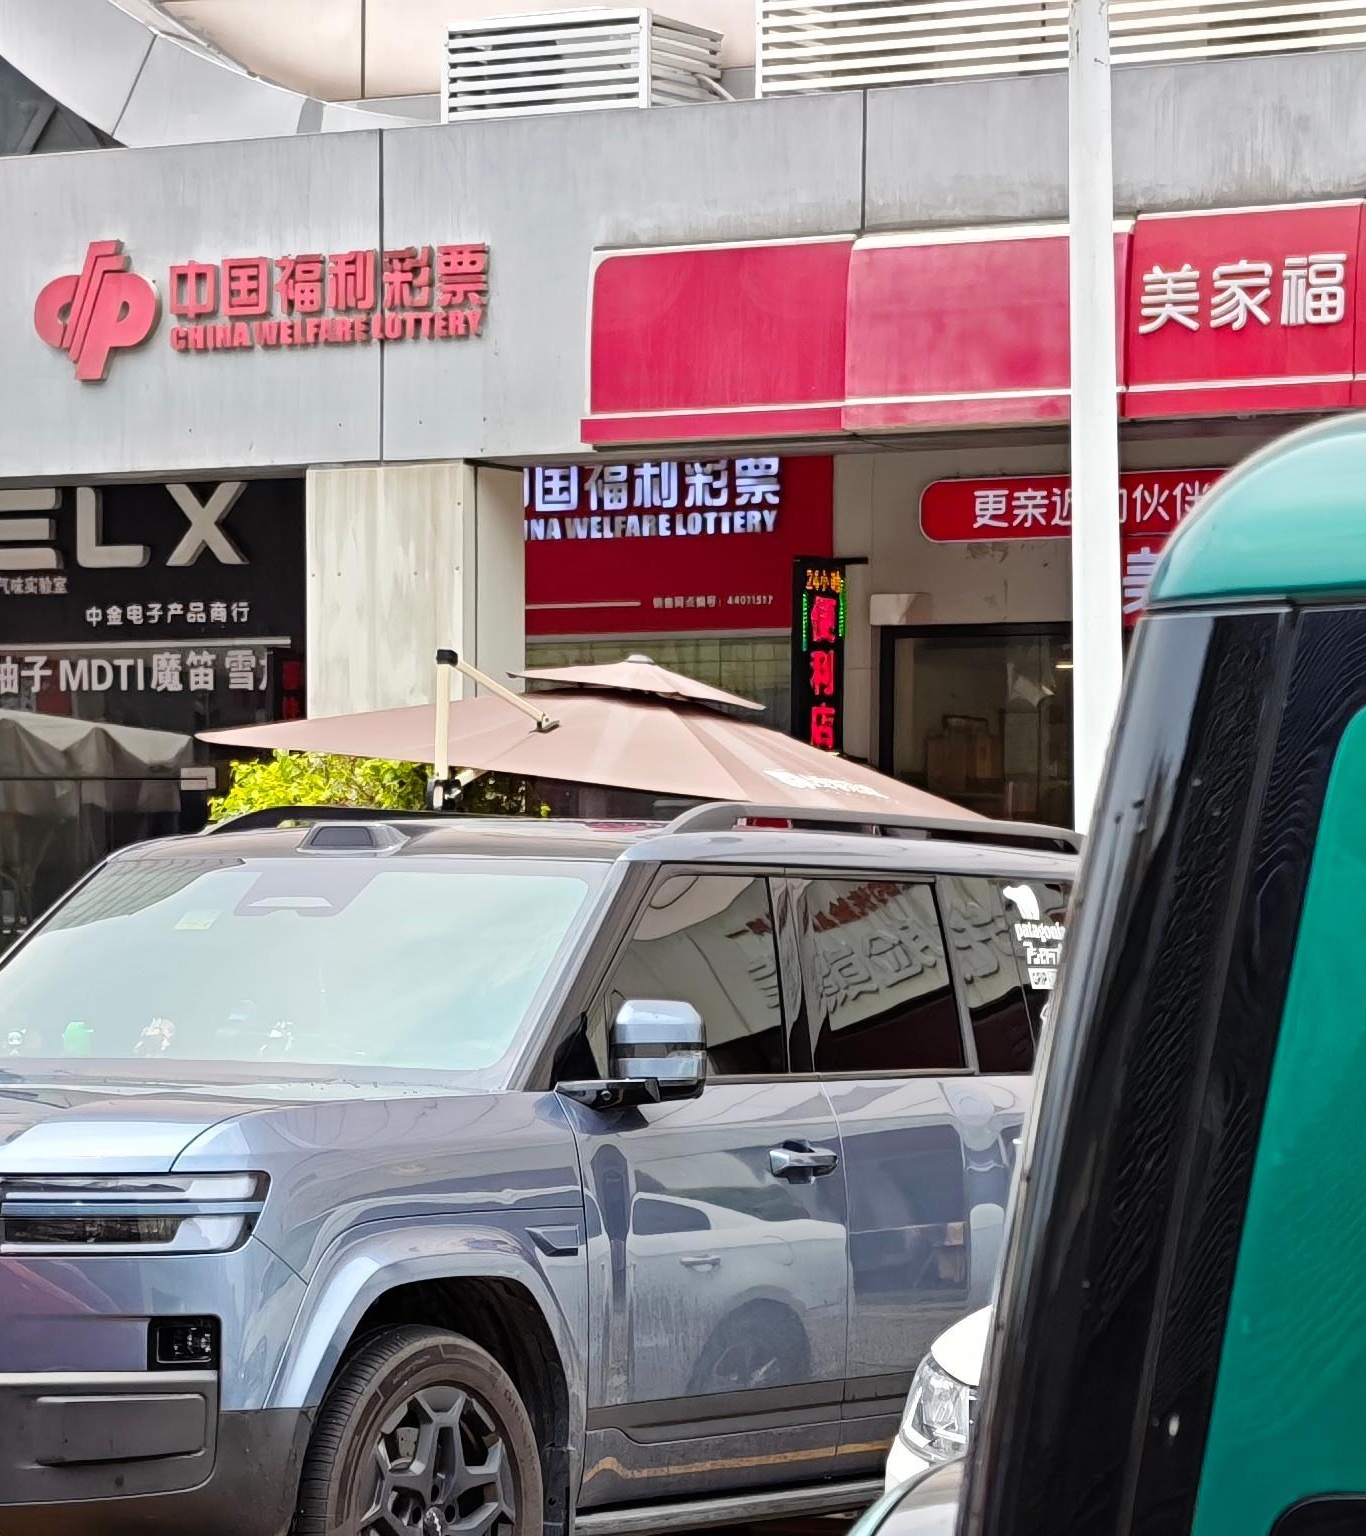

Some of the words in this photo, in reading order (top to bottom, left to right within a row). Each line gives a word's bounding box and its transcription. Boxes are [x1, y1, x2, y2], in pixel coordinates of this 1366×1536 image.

[169, 243, 490, 318] 中国福利彩票
[1137, 251, 1348, 335] 美家福
[170, 322, 254, 352] CHINA
[255, 315, 369, 347] WELFARE
[371, 309, 484, 340] LOTTERY
[523, 457, 781, 512] 国福利彩票
[565, 513, 671, 539] WELFARE
[674, 510, 778, 536] LOTTERY
[85, 601, 251, 627] 中金电子产品商行
[60, 658, 144, 692] MDTI
